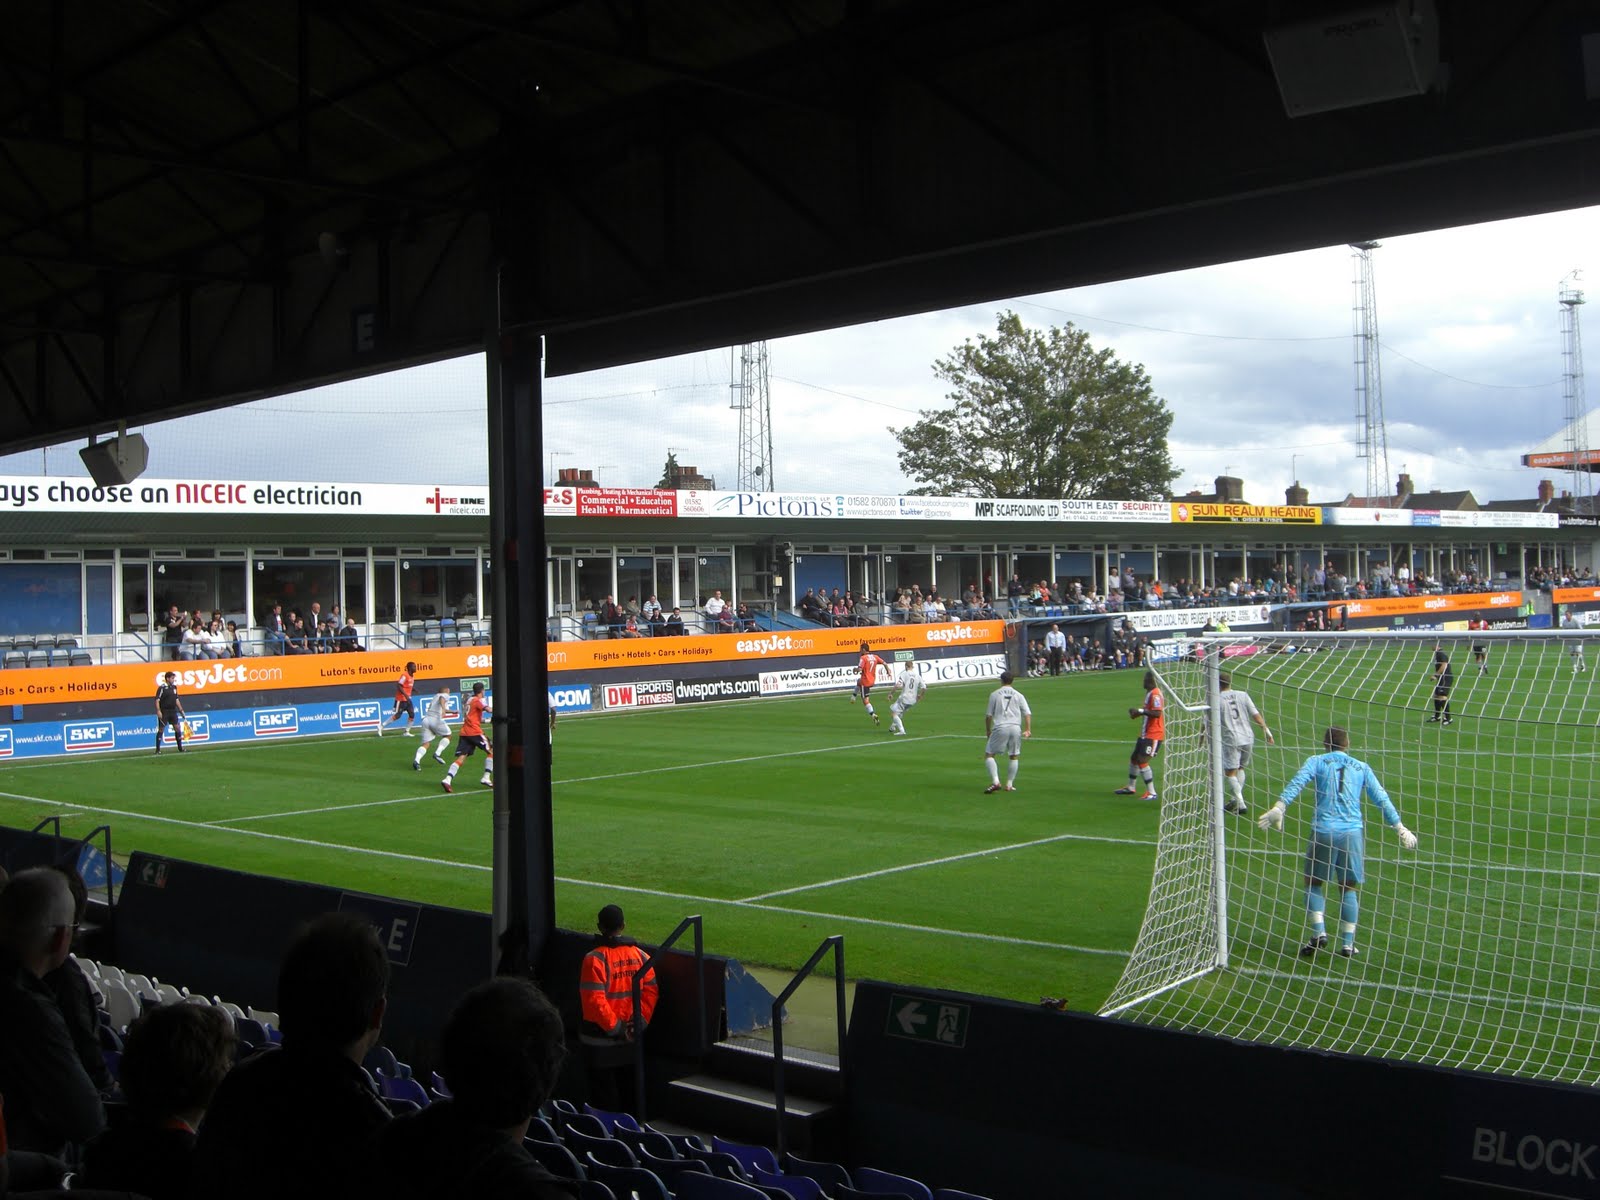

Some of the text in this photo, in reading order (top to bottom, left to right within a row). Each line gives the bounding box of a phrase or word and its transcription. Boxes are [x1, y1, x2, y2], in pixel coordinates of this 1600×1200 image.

[48, 481, 132, 503] choose
[141, 487, 169, 503] an
[176, 484, 246, 504] NICEIC
[253, 485, 362, 505] electrician
[581, 495, 673, 505] Commercial Education
[736, 493, 832, 517] Pictons
[847, 497, 896, 507] 01582 870870
[1062, 501, 1093, 509] SOUTH
[1096, 502, 1118, 510] EAST
[1122, 503, 1163, 511] SECURITY
[581, 505, 608, 514] Health
[615, 506, 673, 515] Pharmaceutical
[996, 504, 1045, 517] SCAFFOLDING
[1047, 505, 1059, 517] LTD
[1192, 505, 1218, 516] SUN
[1224, 506, 1265, 517] REALM
[1270, 506, 1315, 518] HEATING
[577, 559, 584, 568] 8
[619, 558, 625, 567] 9
[699, 557, 707, 566] 10
[885, 555, 892, 563] 12
[158, 564, 166, 574] 4
[258, 561, 265, 571] 5
[403, 561, 410, 570] 6
[860, 636, 887, 645] favourite
[888, 635, 906, 643] airline
[926, 625, 990, 643] easyJet.com
[736, 635, 813, 654] easyJet.com
[594, 647, 713, 661] Flights Hotels Cars Holidays
[320, 663, 434, 677] Luton's favourite aline
[870, 662, 875, 672] 7
[917, 659, 1007, 680] Pictons
[28, 684, 55, 694] Cars
[67, 680, 118, 692] Holidays
[637, 682, 673, 694] SPORTS
[909, 678, 914, 689] 8
[676, 680, 760, 700] dwsports.com
[608, 687, 633, 706] DW
[637, 693, 673, 705] FITNESS
[1004, 696, 1012, 711] 7
[15, 733, 62, 744] www.skf.co.uk
[71, 727, 109, 740] SKF
[211, 720, 252, 729] www.skf.co.uk
[259, 713, 293, 726] SKF
[300, 712, 338, 722] www.skf.co.uk
[345, 707, 377, 719] SKF
[1146, 746, 1151, 754] 8
[1336, 765, 1345, 795] 1
[388, 918, 408, 952] E
[1472, 1127, 1600, 1180] BLOCK
